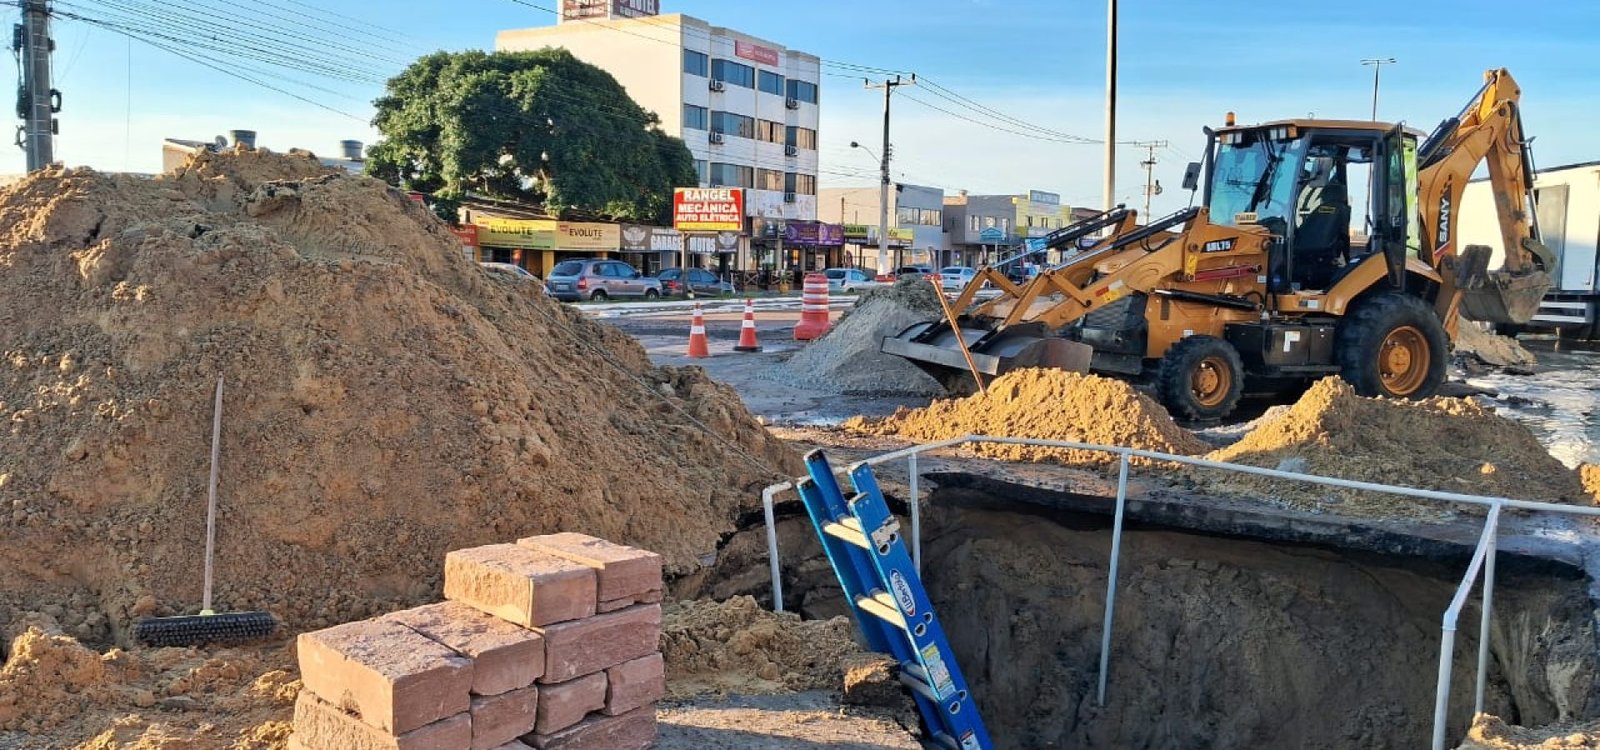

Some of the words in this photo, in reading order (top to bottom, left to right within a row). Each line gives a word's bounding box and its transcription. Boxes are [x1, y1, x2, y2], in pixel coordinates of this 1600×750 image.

[683, 190, 736, 201] RANGEL
[678, 201, 738, 213] MECÂNICA
[676, 213, 699, 222] AUTO
[700, 213, 739, 222] ELÉTRICA
[1439, 198, 1450, 242] SANY
[491, 225, 533, 236] EVOLUTE
[569, 228, 603, 237] EVOLUTE
